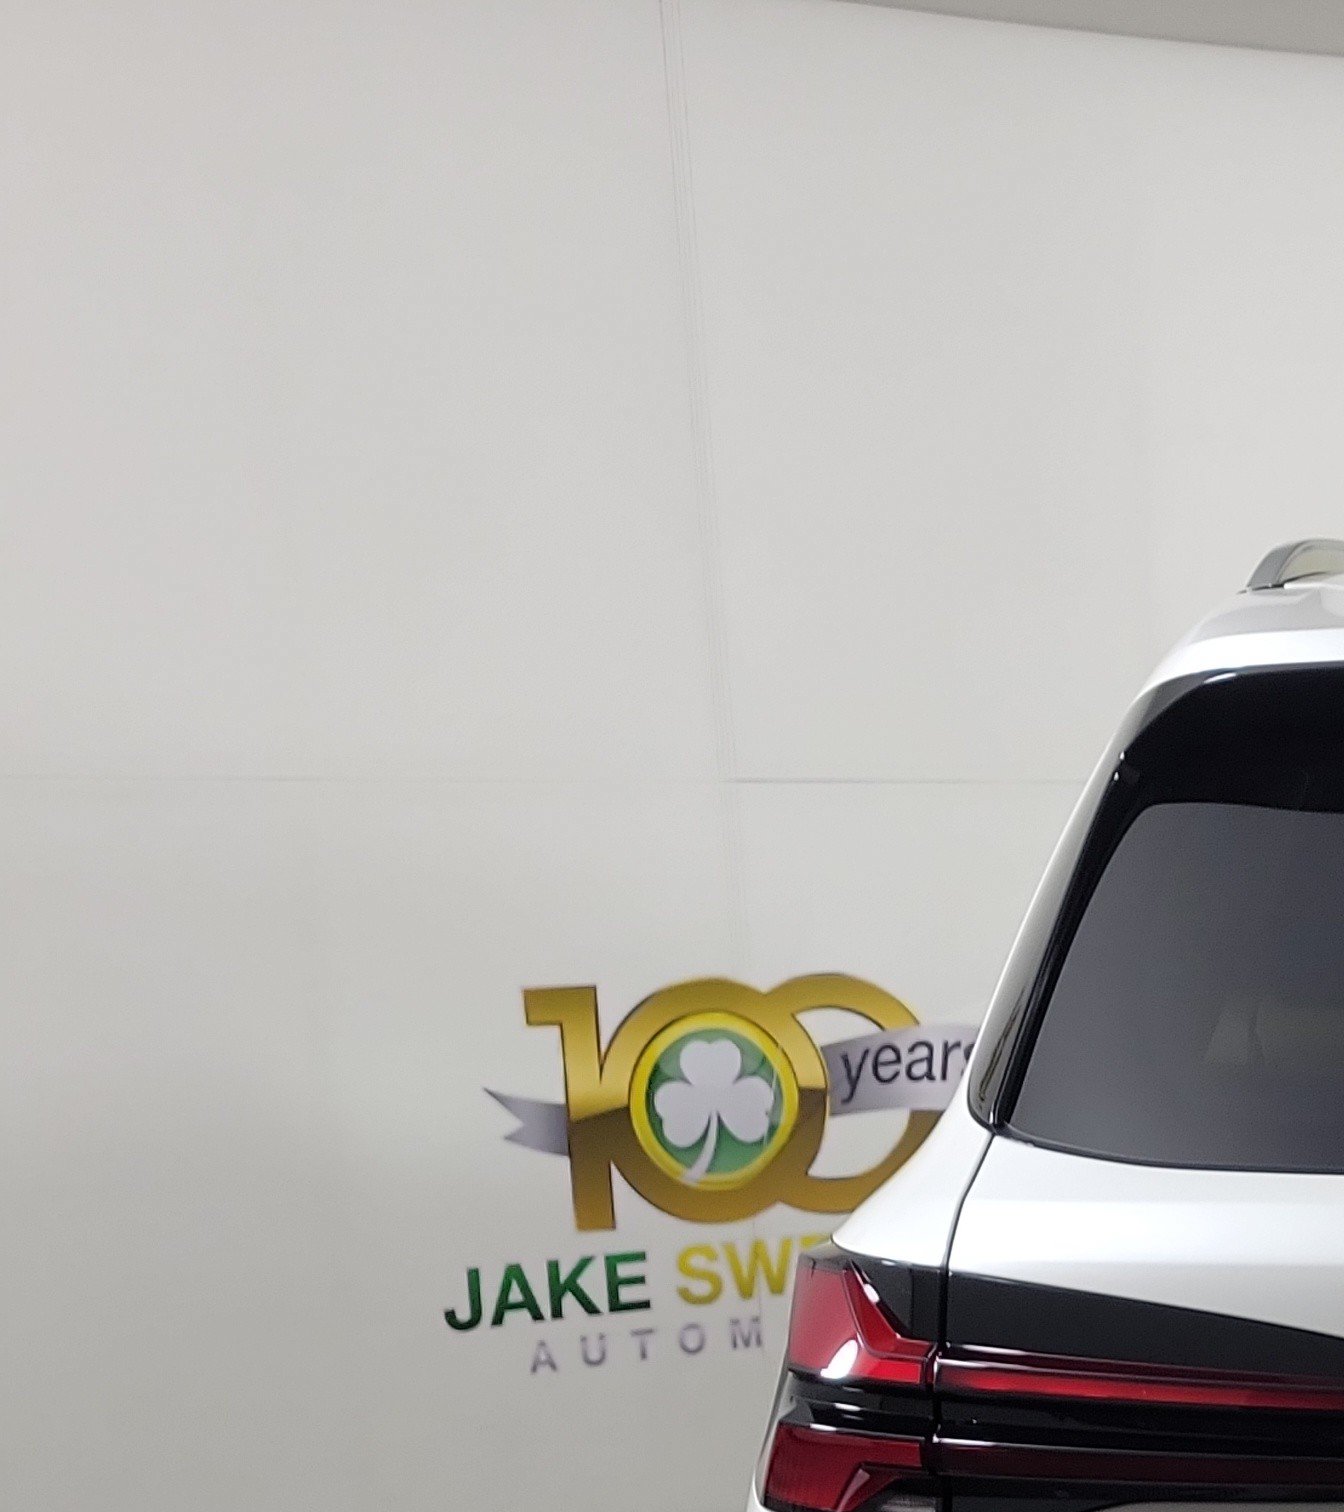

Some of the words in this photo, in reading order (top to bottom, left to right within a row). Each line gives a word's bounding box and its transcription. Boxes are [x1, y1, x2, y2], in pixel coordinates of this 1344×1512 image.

[444, 1251, 652, 1331] JAKE
[676, 1233, 832, 1305] SW
[530, 1318, 763, 1375] AUTOM
